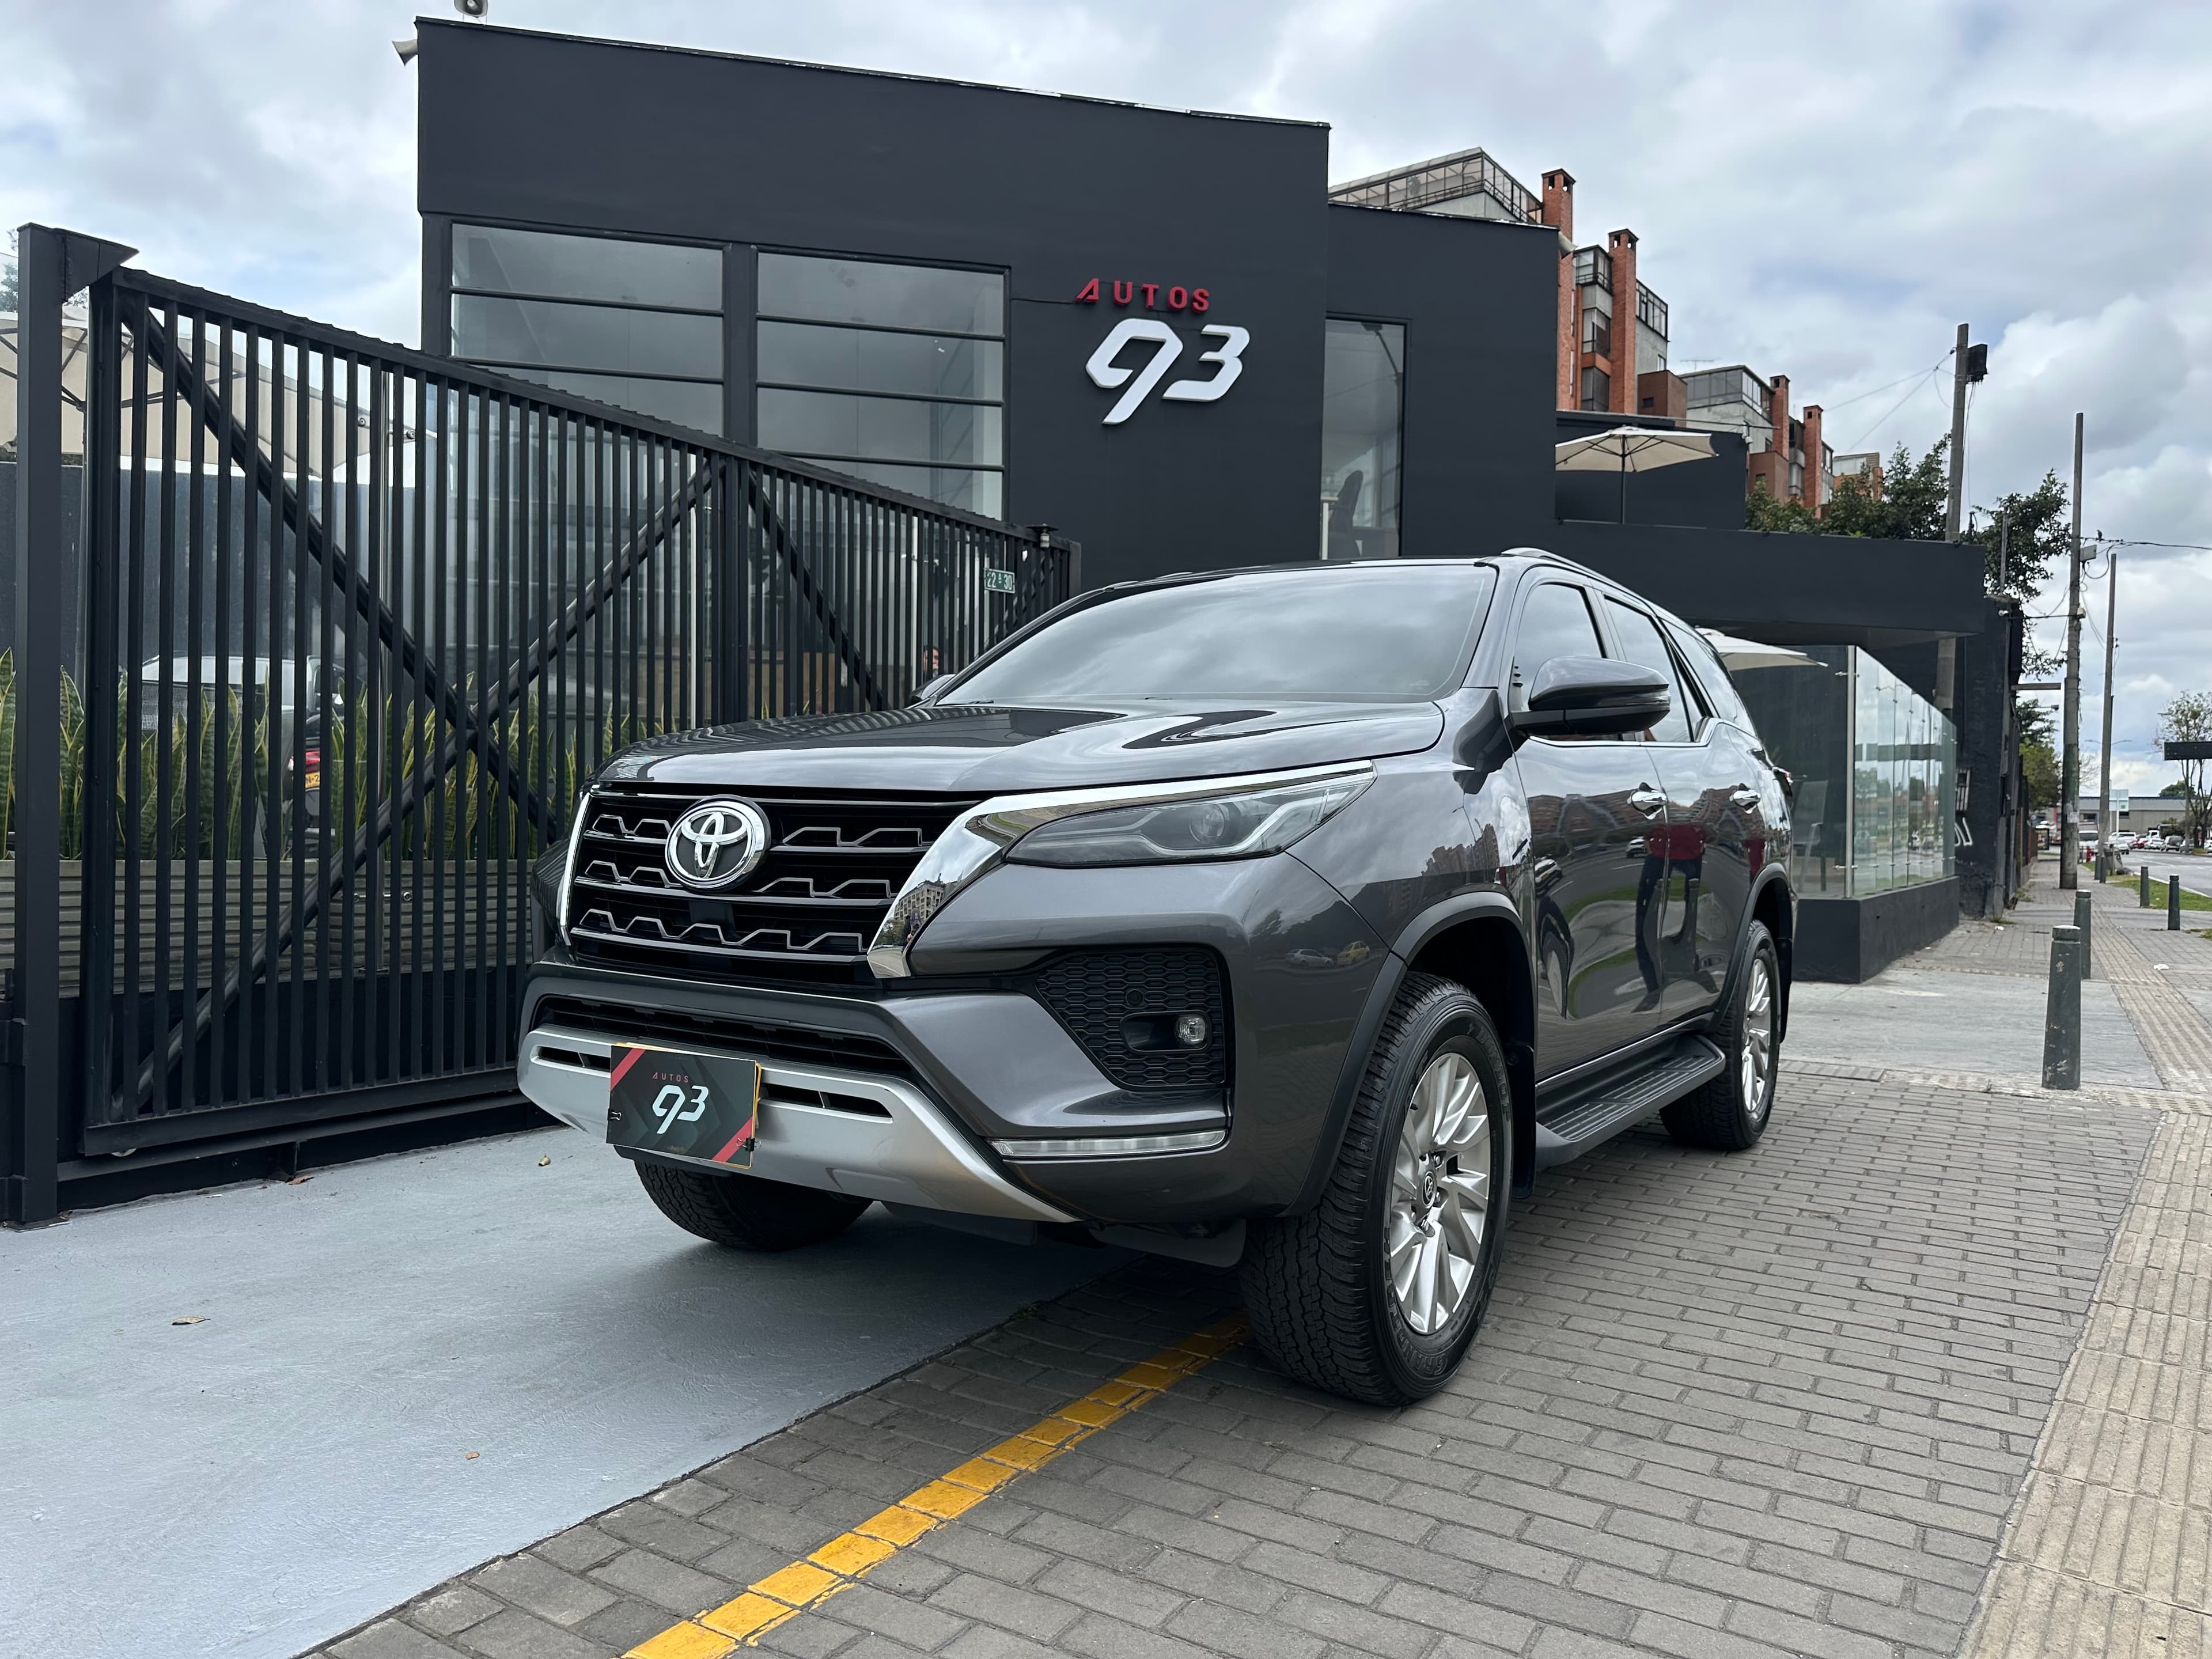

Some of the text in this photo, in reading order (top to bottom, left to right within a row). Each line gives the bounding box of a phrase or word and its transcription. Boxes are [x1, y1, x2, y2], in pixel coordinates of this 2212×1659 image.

[1076, 278, 1209, 312] AUTOS
[1086, 318, 1250, 425] 93
[652, 1071, 690, 1083] AUTOS
[652, 1085, 709, 1134] 93
